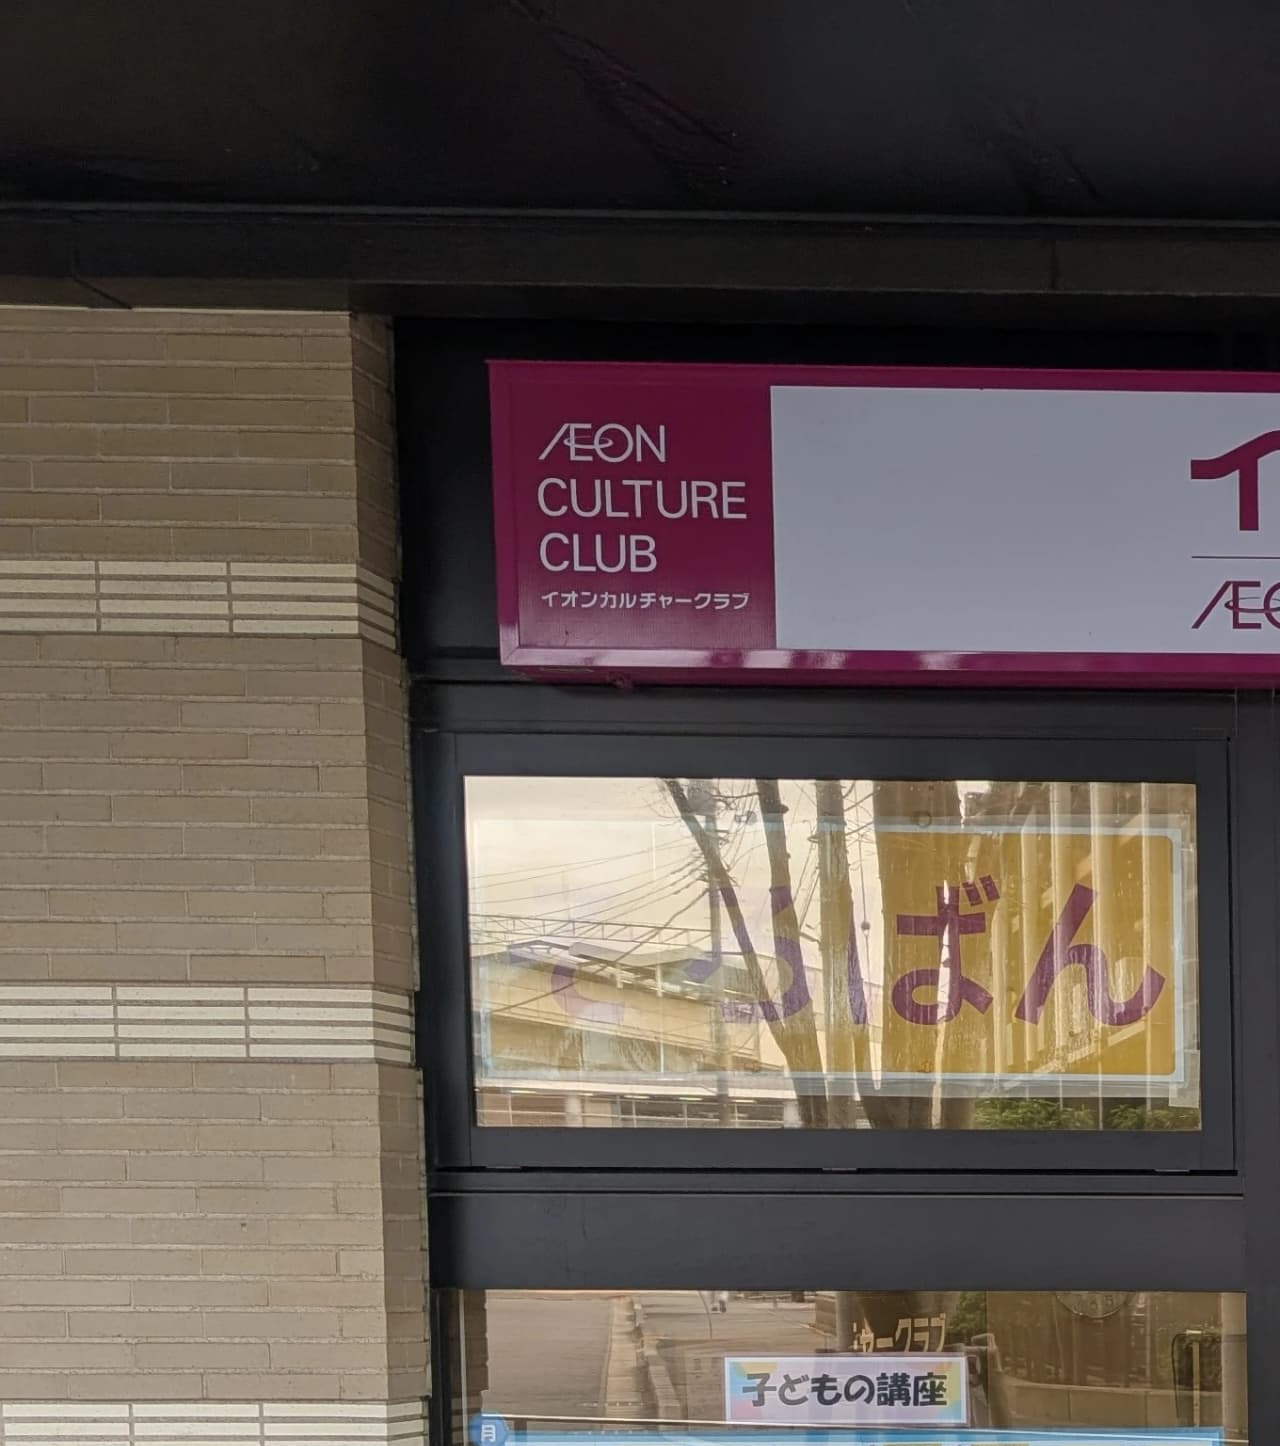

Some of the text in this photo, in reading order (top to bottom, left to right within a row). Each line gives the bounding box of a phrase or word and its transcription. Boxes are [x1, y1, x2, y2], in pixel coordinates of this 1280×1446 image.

[537, 478, 748, 521] CULTURE
[538, 533, 658, 574] CLUB
[540, 590, 752, 612] イオンカルチャークラブ
[742, 1371, 948, 1408] 子どもの講座
